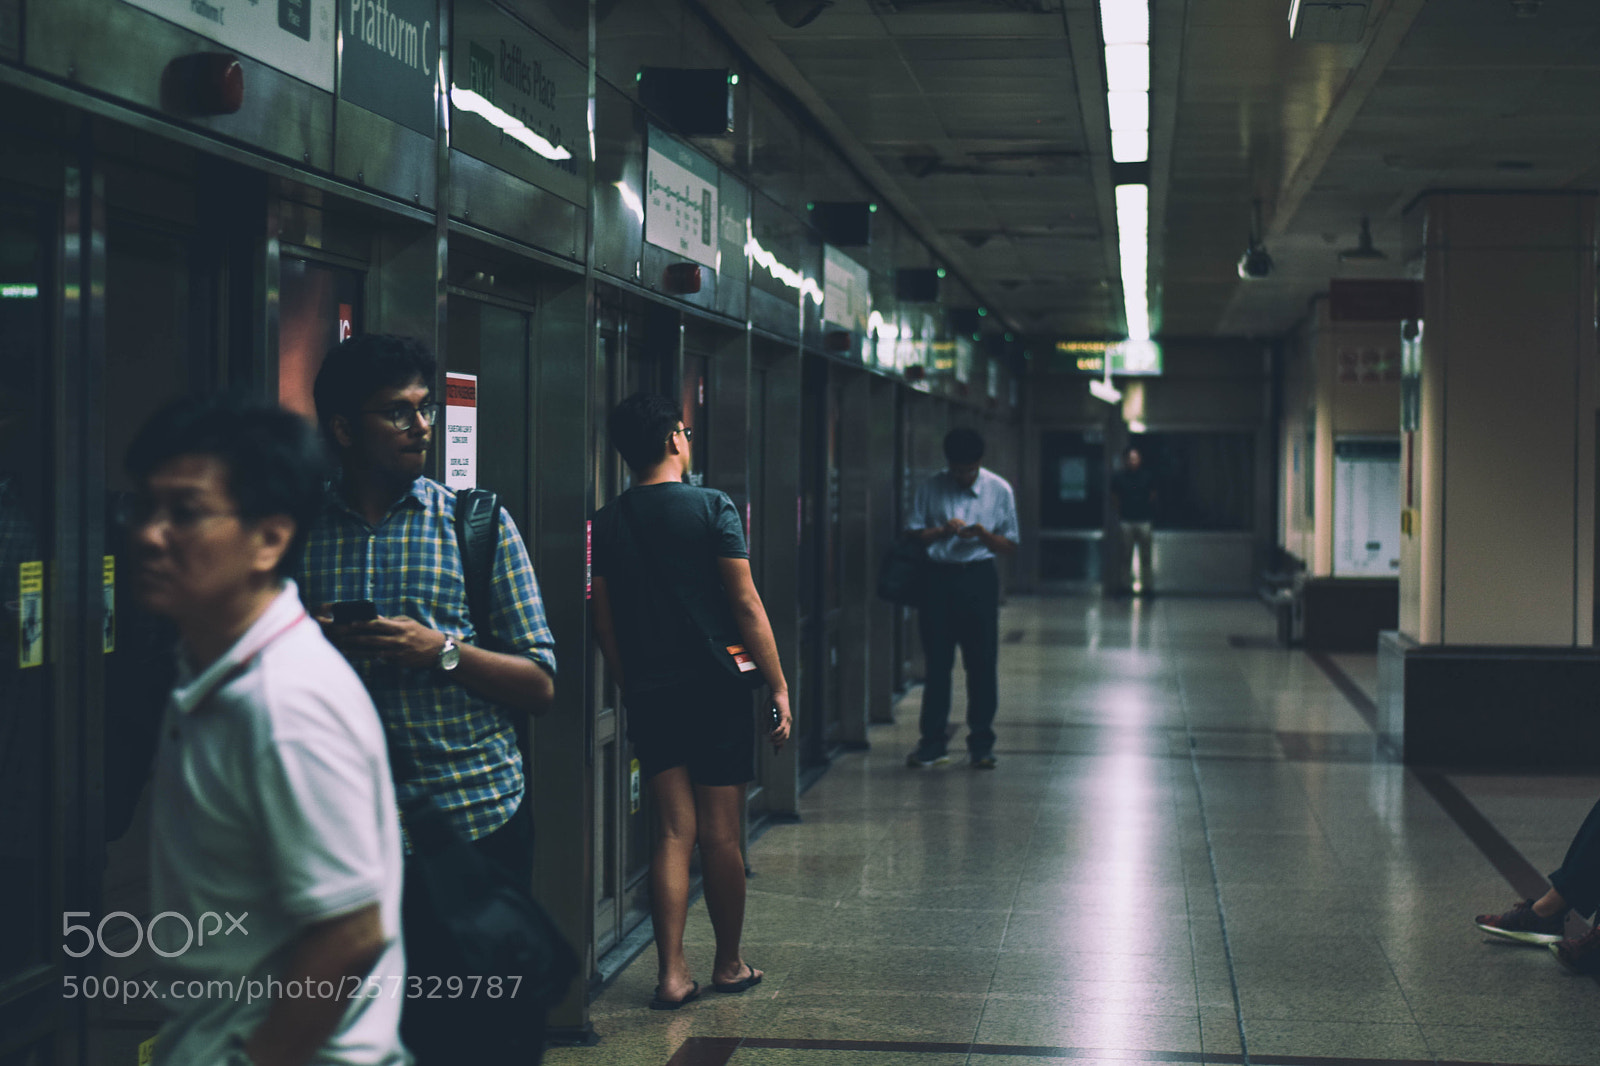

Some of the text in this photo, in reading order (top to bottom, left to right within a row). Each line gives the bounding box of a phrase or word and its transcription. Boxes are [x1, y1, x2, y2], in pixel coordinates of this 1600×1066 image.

[350, 0, 418, 69] Platform
[422, 20, 431, 76] C
[499, 38, 556, 112] Raffles Place
